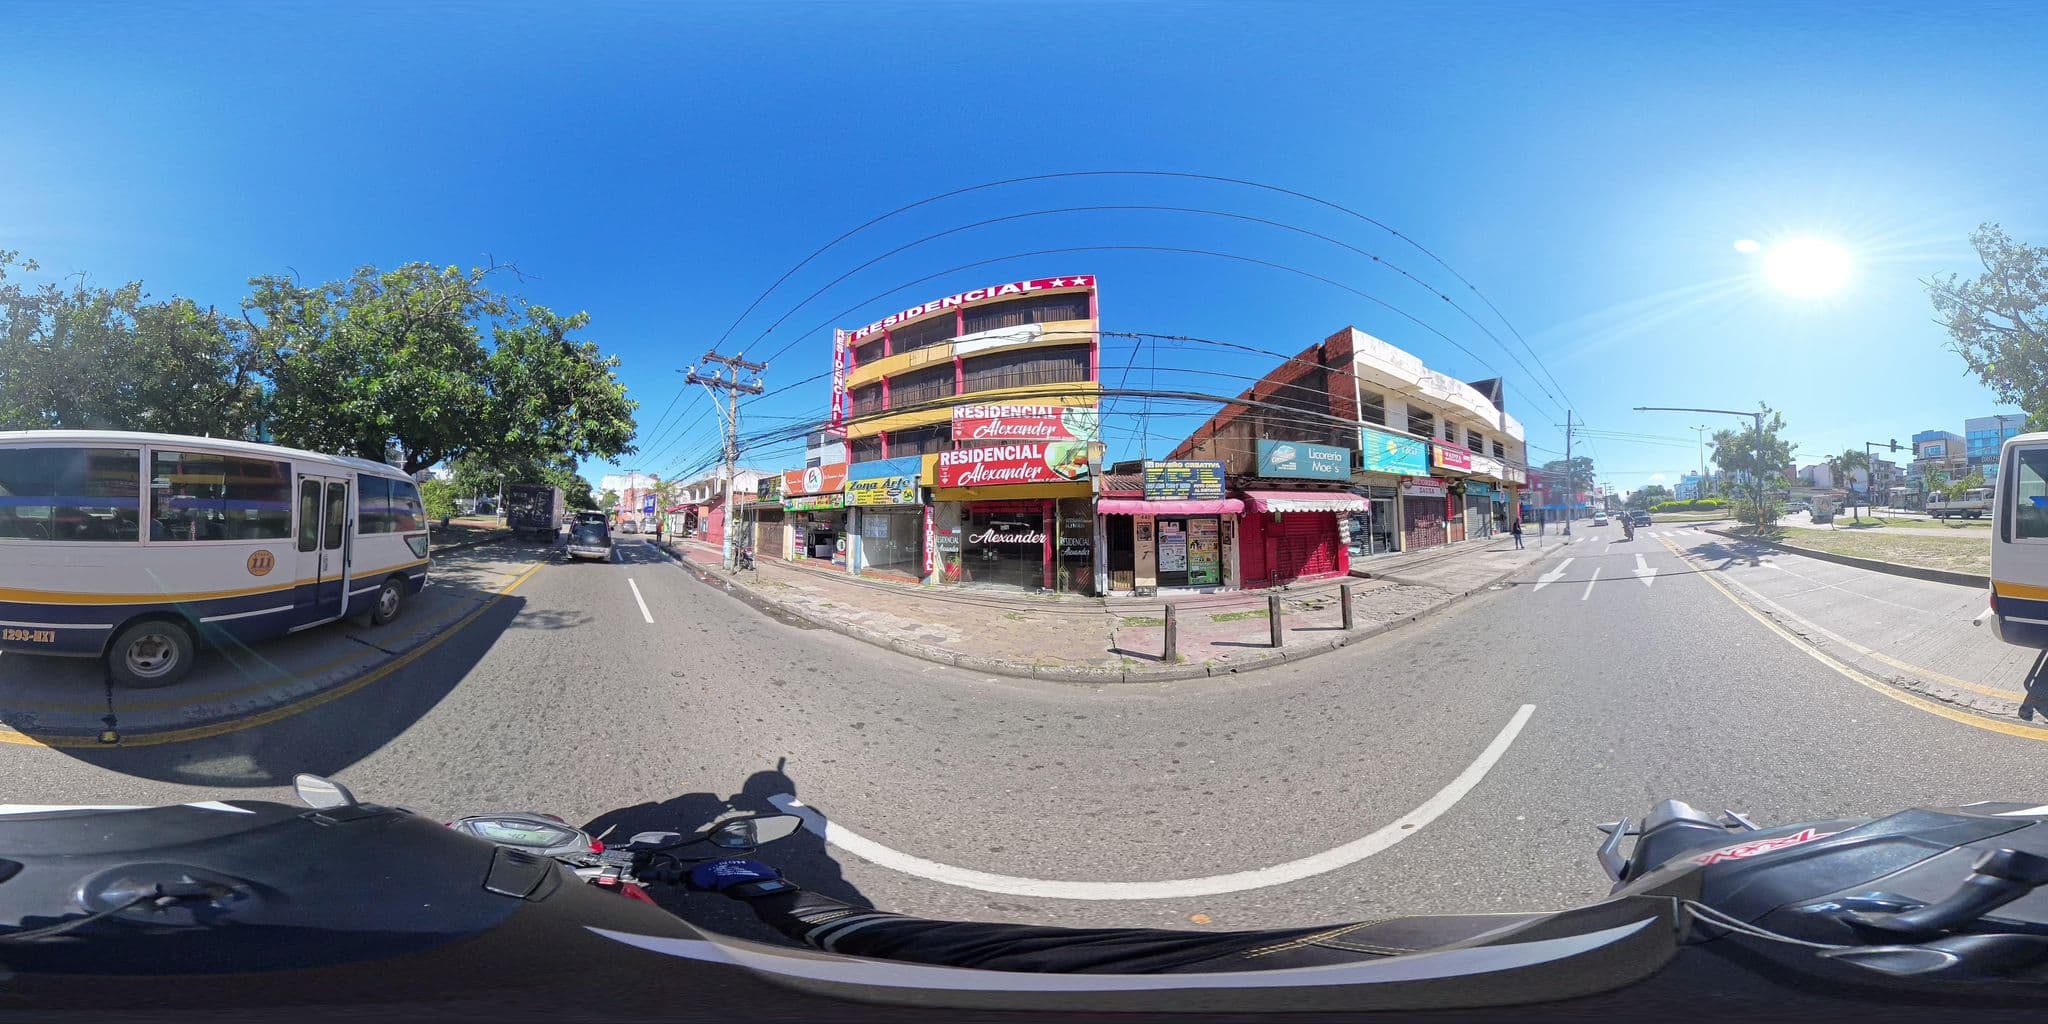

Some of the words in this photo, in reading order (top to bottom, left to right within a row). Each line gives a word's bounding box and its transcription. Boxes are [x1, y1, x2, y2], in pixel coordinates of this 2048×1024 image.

[856, 279, 1042, 340] RESIDENCIAL
[833, 329, 845, 420] RESIDENCIAL
[953, 405, 1057, 419] RESIDENCIAL
[973, 418, 1056, 439] Alexander
[940, 444, 1042, 466] RESIDENCIAL
[849, 481, 878, 491] Zona
[881, 477, 911, 489] Arte
[958, 462, 1042, 486] Alexander
[926, 506, 934, 571] RESIDENCIAL
[968, 528, 1047, 544] Alexander
